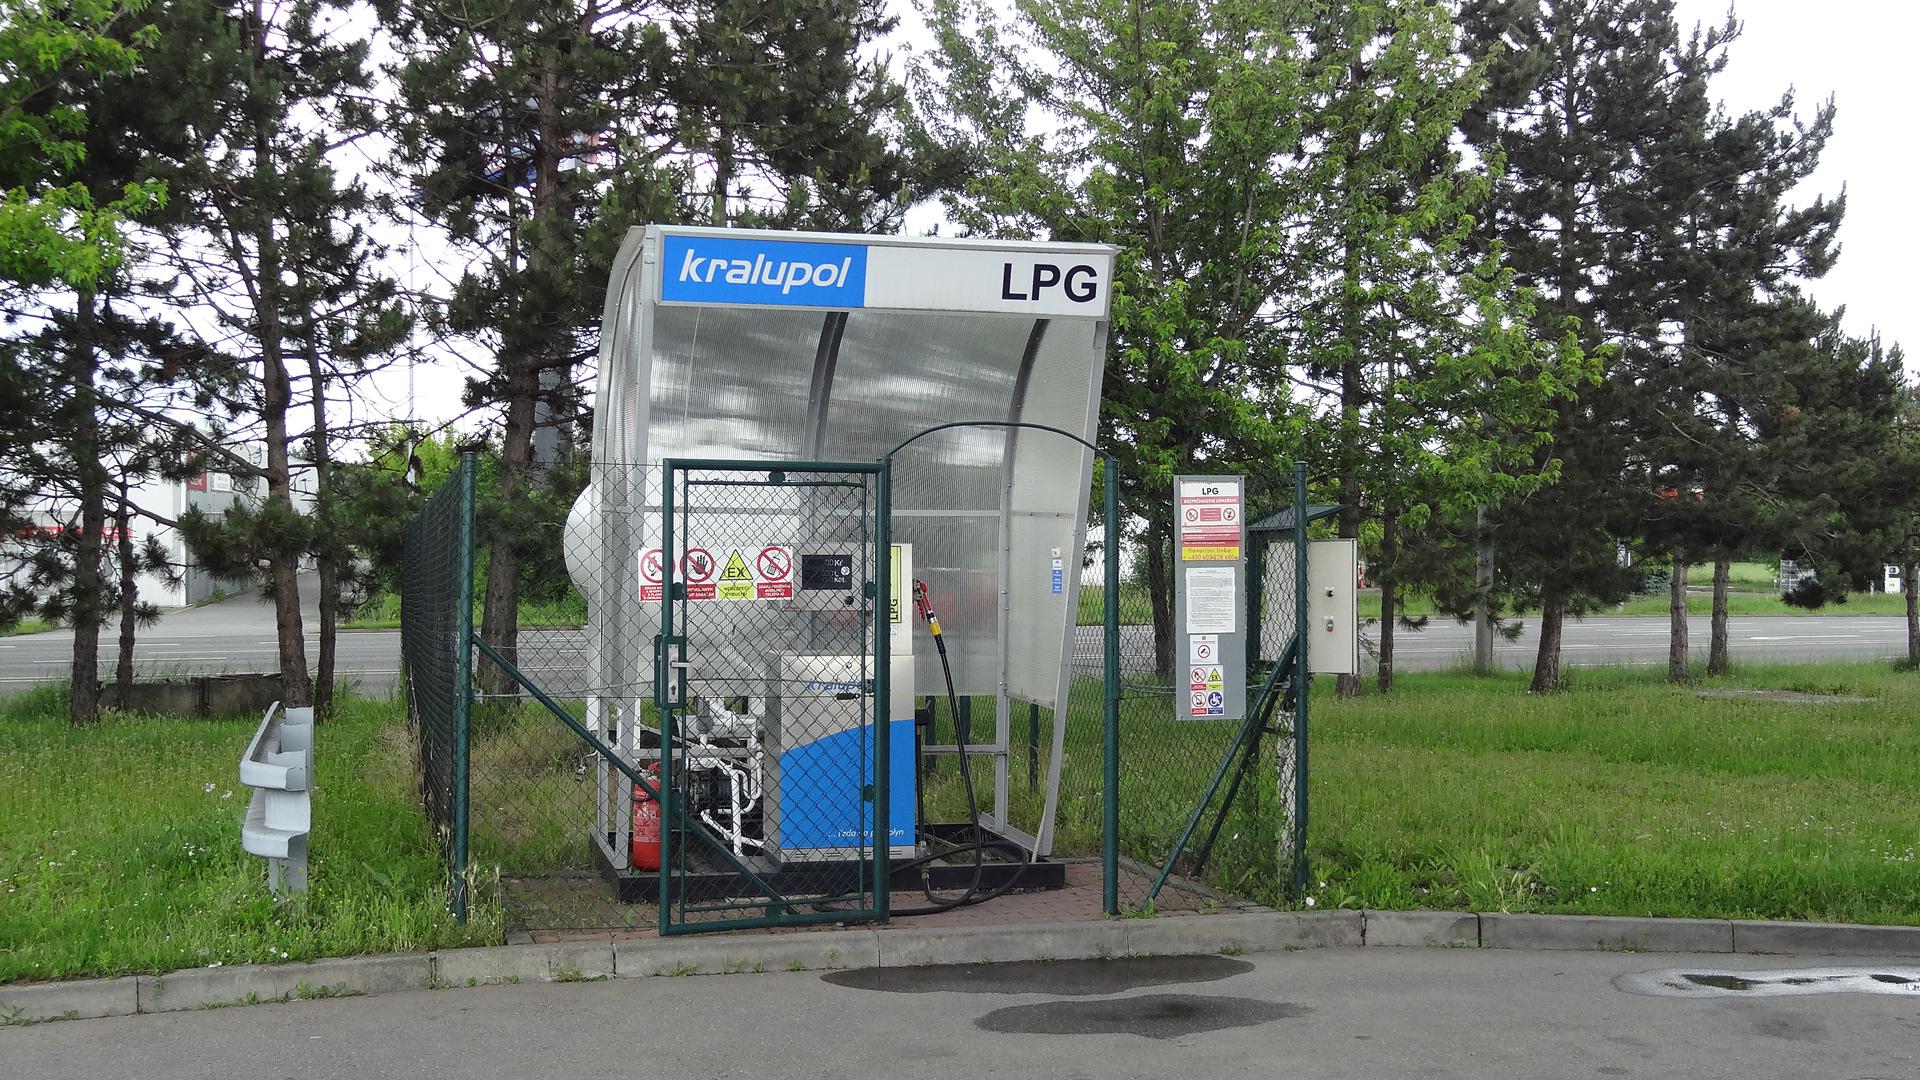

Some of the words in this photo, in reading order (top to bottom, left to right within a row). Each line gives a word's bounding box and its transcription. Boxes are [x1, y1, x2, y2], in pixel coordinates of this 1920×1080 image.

[679, 248, 852, 294] kralupol
[1001, 262, 1098, 303] LPG
[1202, 487, 1219, 496] LPG
[728, 567, 745, 578] EX
[890, 598, 898, 620] LPG
